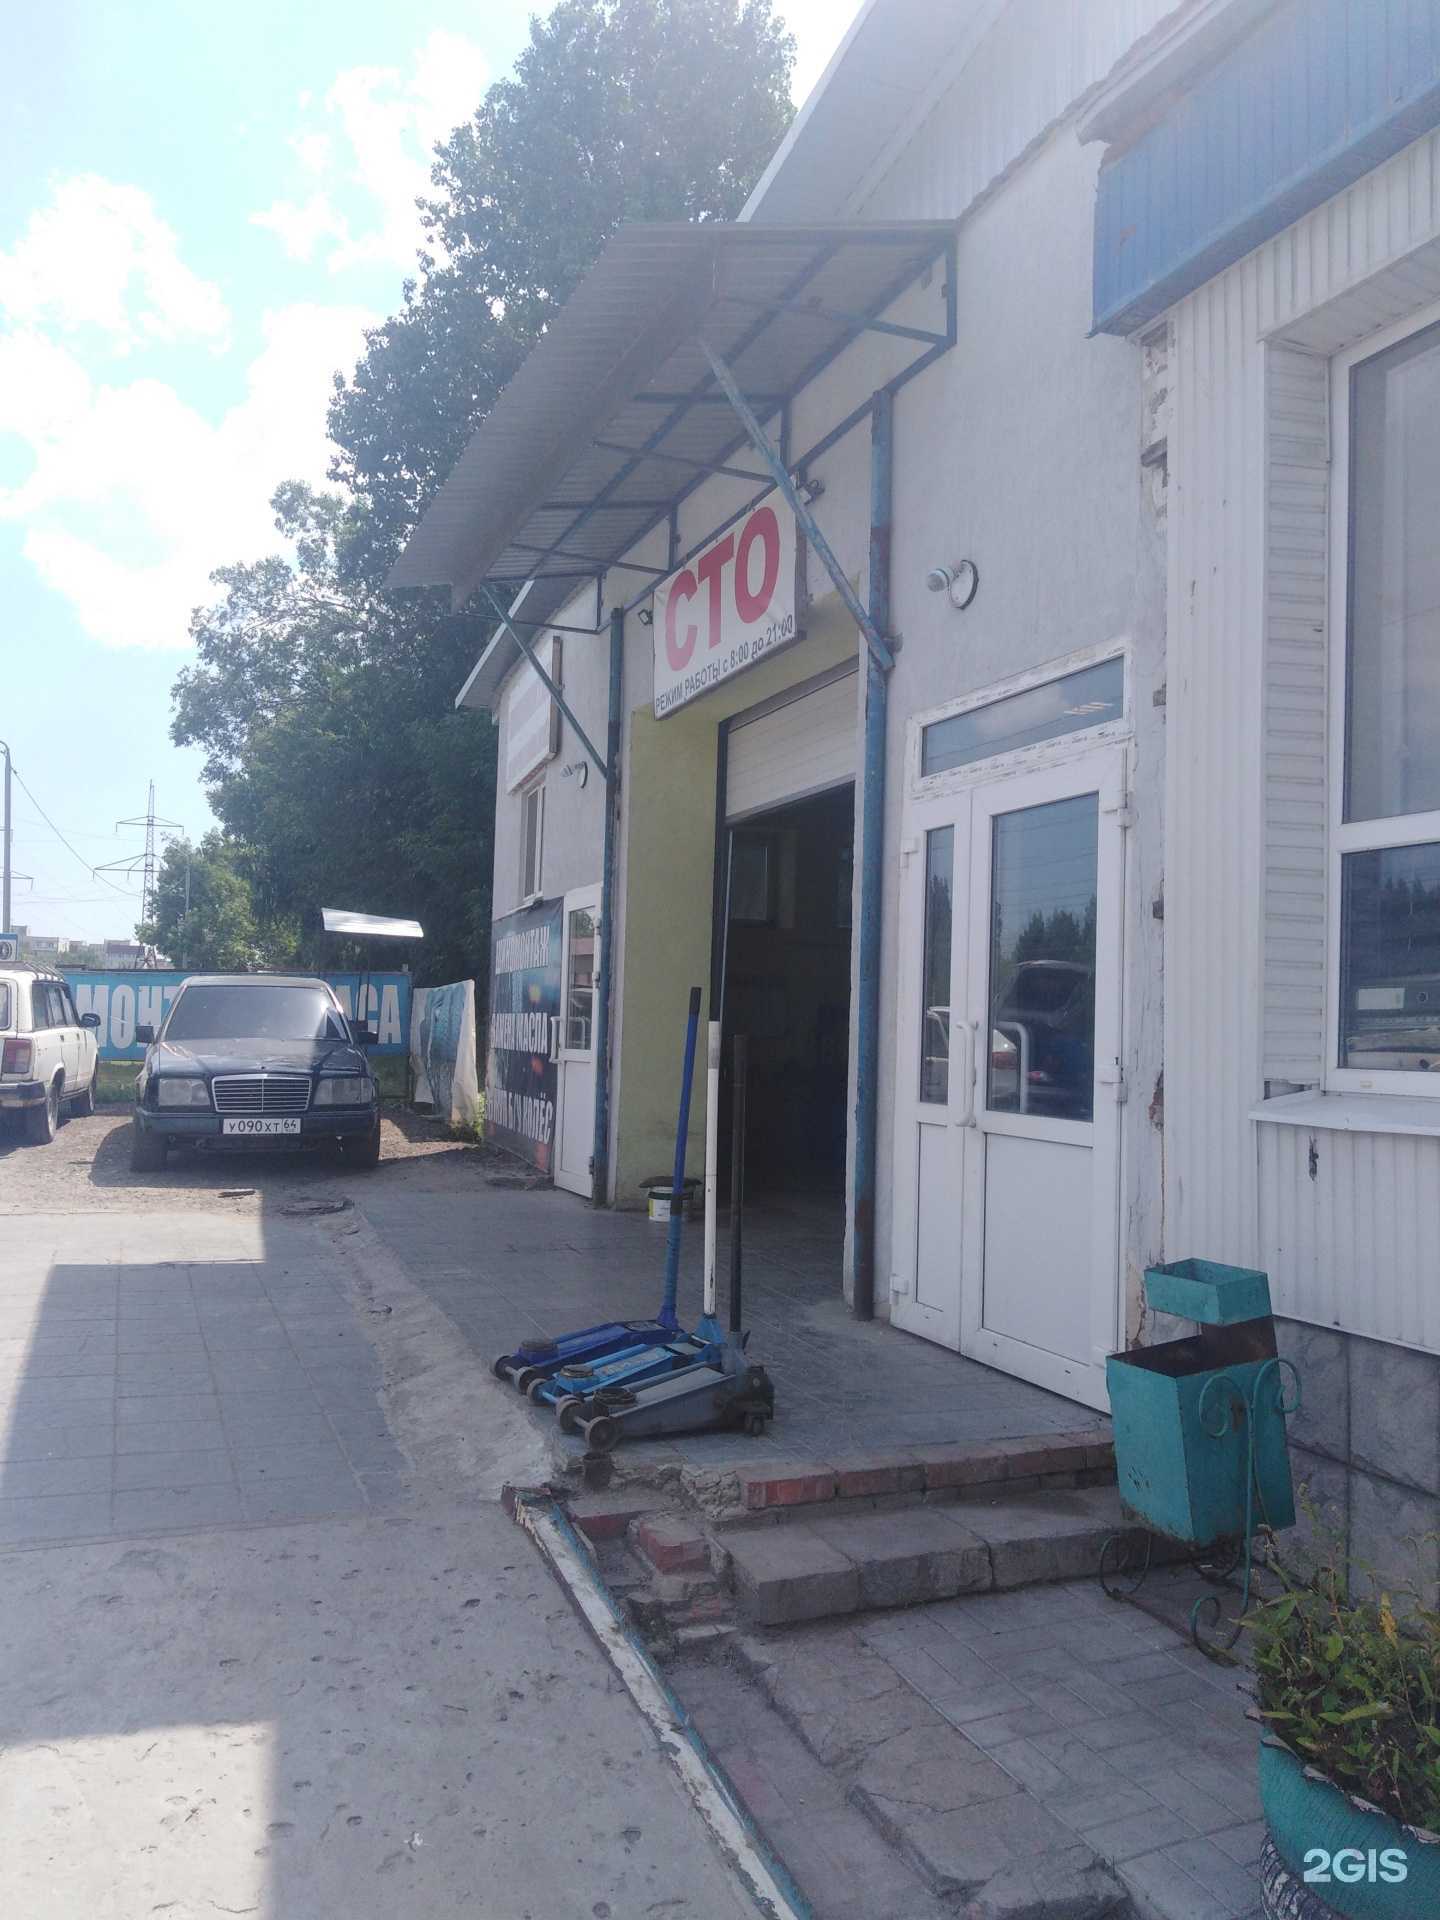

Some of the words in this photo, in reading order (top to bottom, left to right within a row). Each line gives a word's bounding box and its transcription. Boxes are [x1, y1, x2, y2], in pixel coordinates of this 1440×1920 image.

[665, 506, 780, 671] СТО
[655, 683, 683, 713] РЕЖИМ
[685, 659, 720, 696] РАБОТЫ
[730, 642, 749, 668] 8:00
[752, 637, 764, 660] до
[766, 614, 793, 647] 21:00
[516, 1012, 548, 1054] МАСЛА
[283, 1119, 297, 1129] 64
[522, 1092, 553, 1144] КОЛЁС
